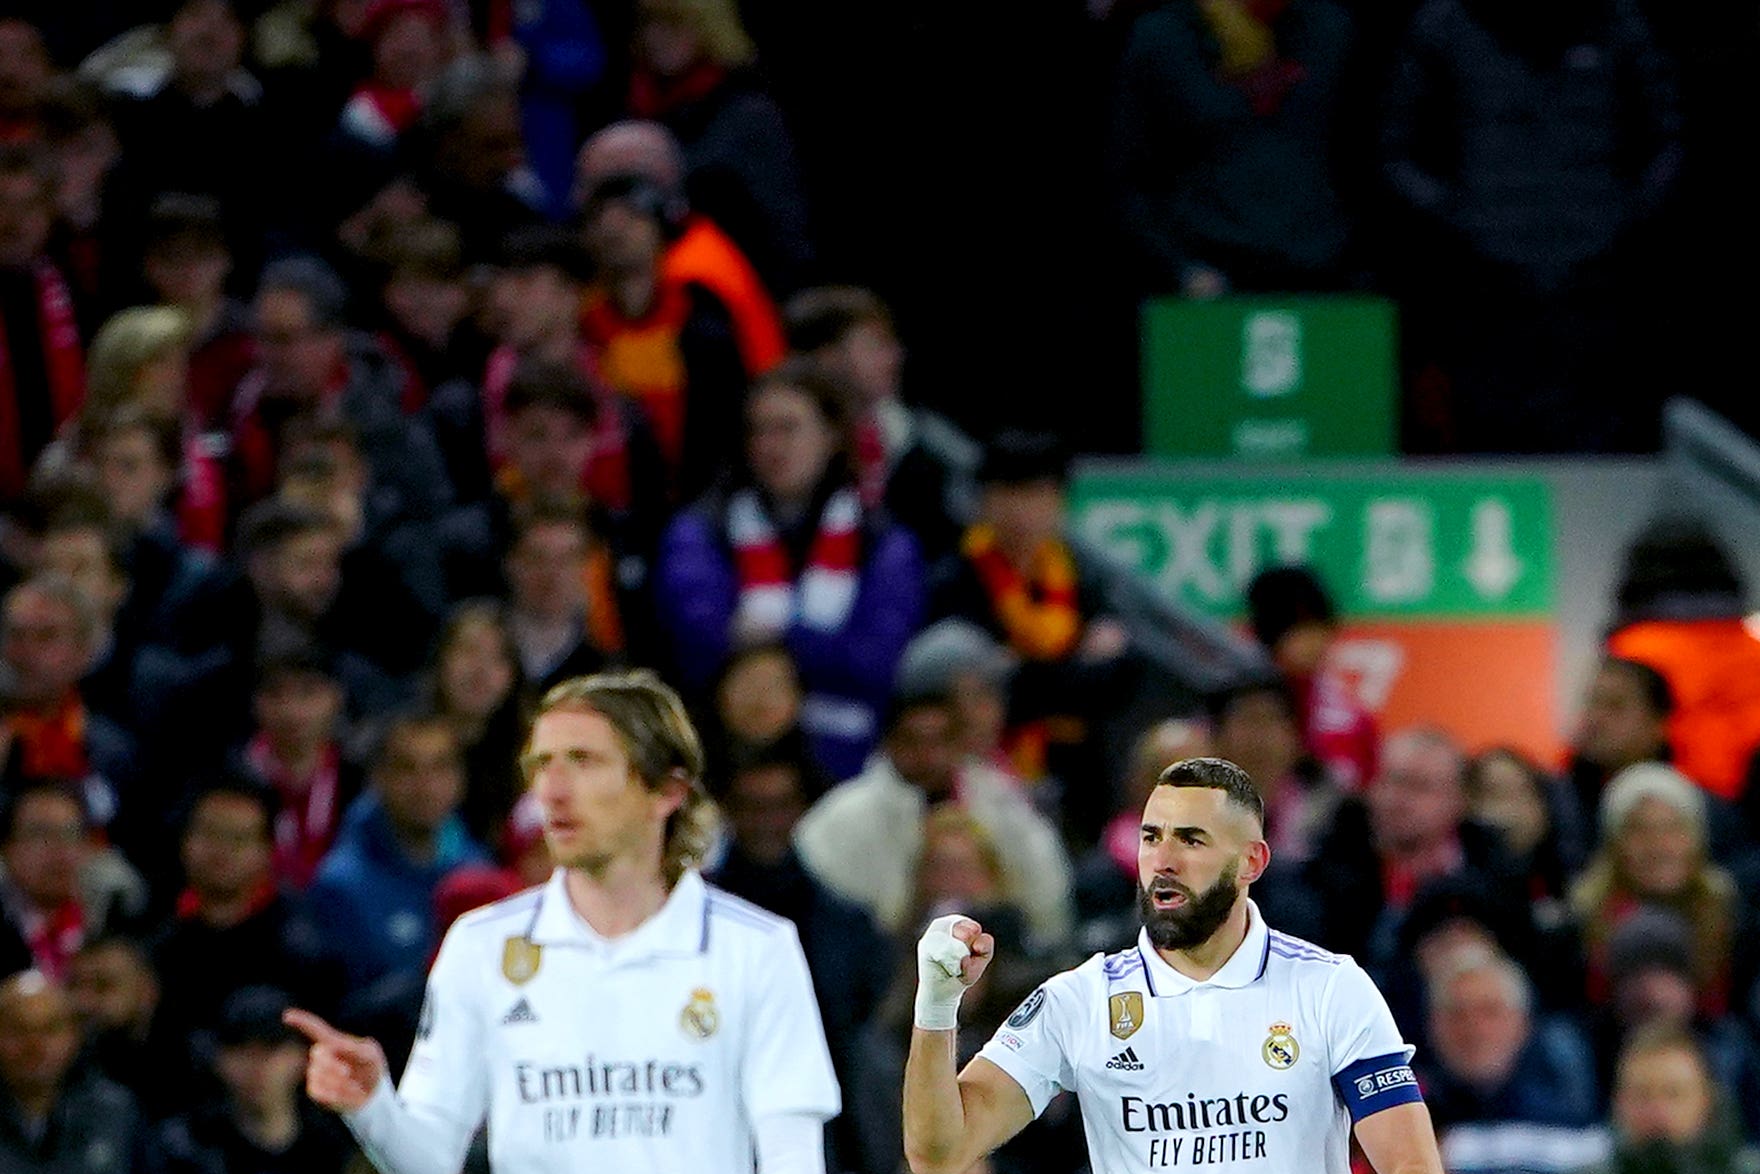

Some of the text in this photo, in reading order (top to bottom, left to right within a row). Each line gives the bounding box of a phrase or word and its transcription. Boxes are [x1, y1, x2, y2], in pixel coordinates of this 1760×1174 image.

[513, 1053, 705, 1104] Emirates
[1105, 1060, 1144, 1071] adidas
[1120, 1090, 1289, 1132] Emirates
[1150, 1130, 1267, 1168] FLY BETTER
